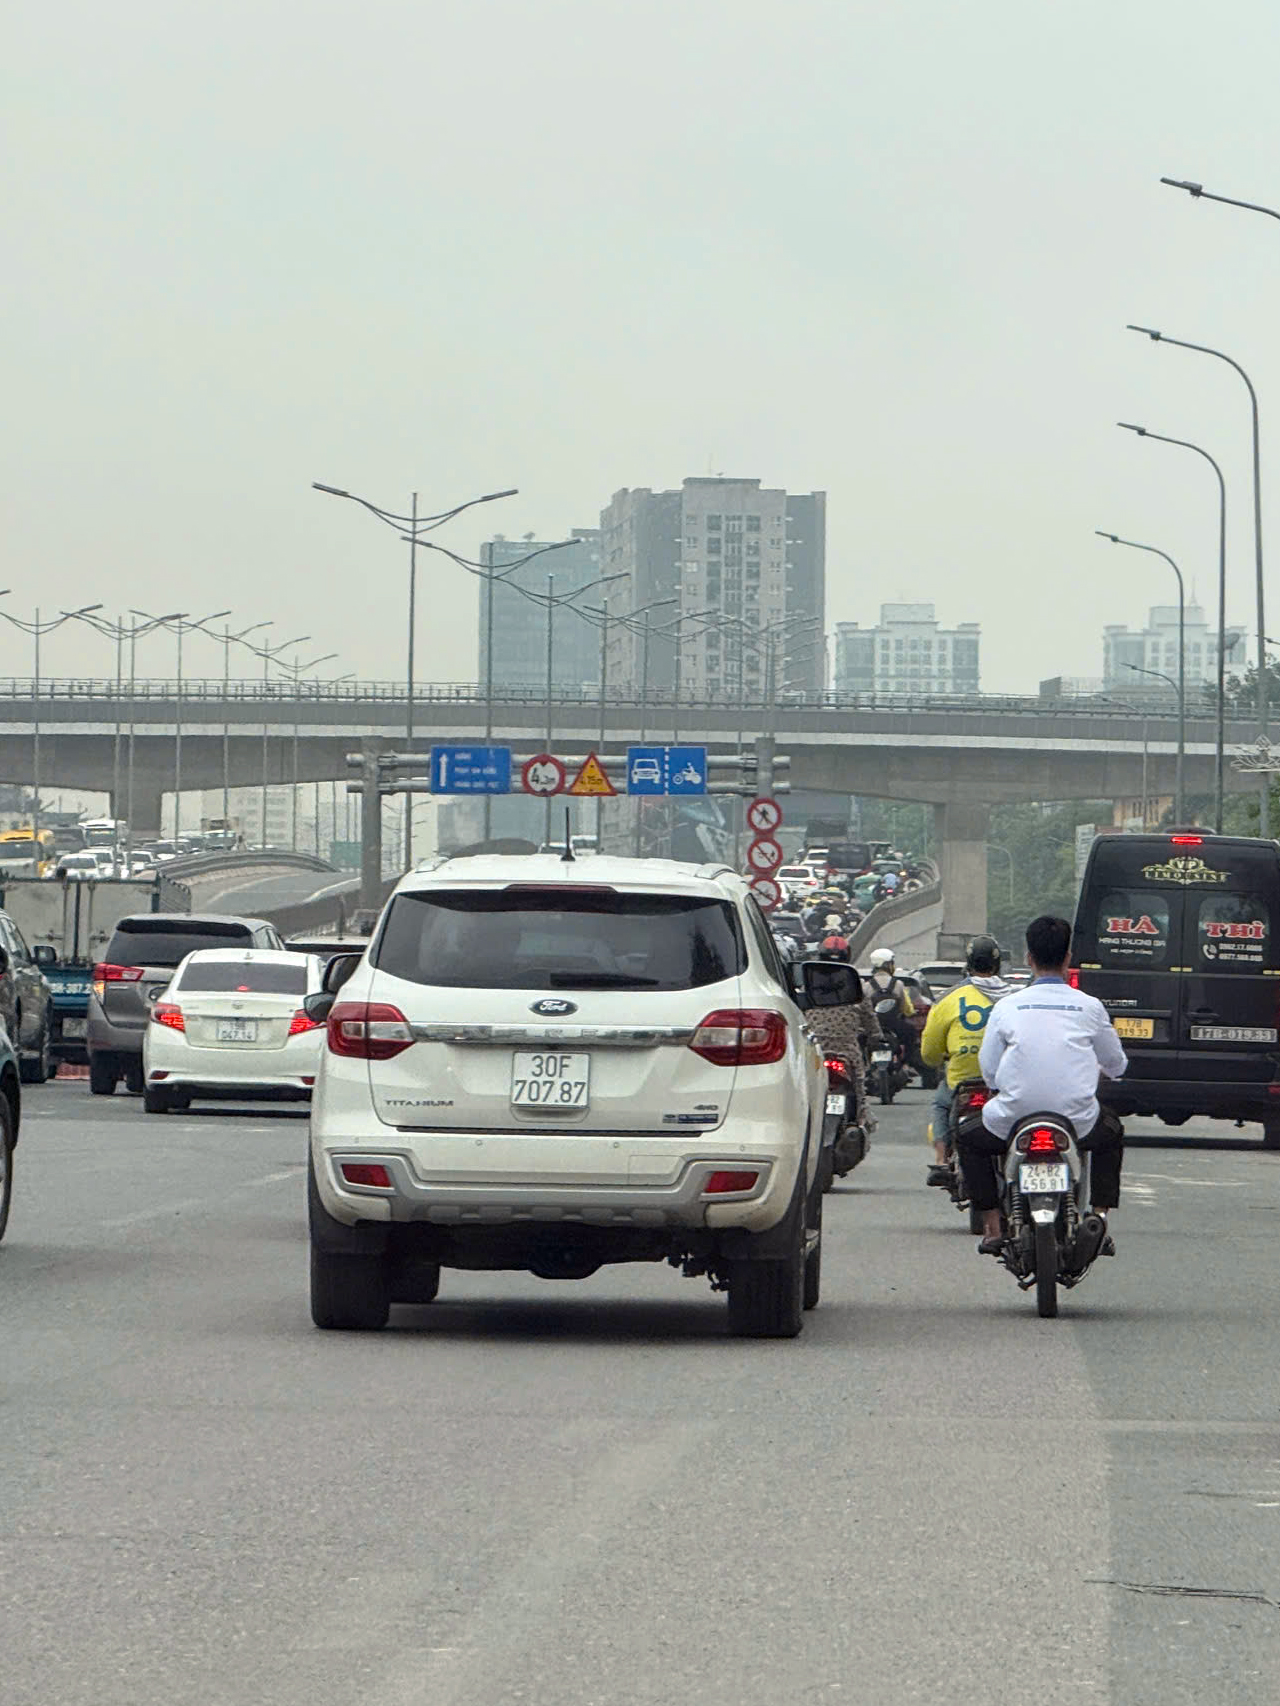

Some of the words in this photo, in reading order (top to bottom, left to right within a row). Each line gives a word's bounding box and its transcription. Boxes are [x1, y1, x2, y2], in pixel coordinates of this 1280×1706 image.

[539, 1000, 567, 1012] Ford
[1102, 999, 1138, 1008] YUNDAI
[531, 1055, 573, 1078] 30F
[514, 1079, 587, 1104] 707.87
[385, 1099, 454, 1107] TITANIUM
